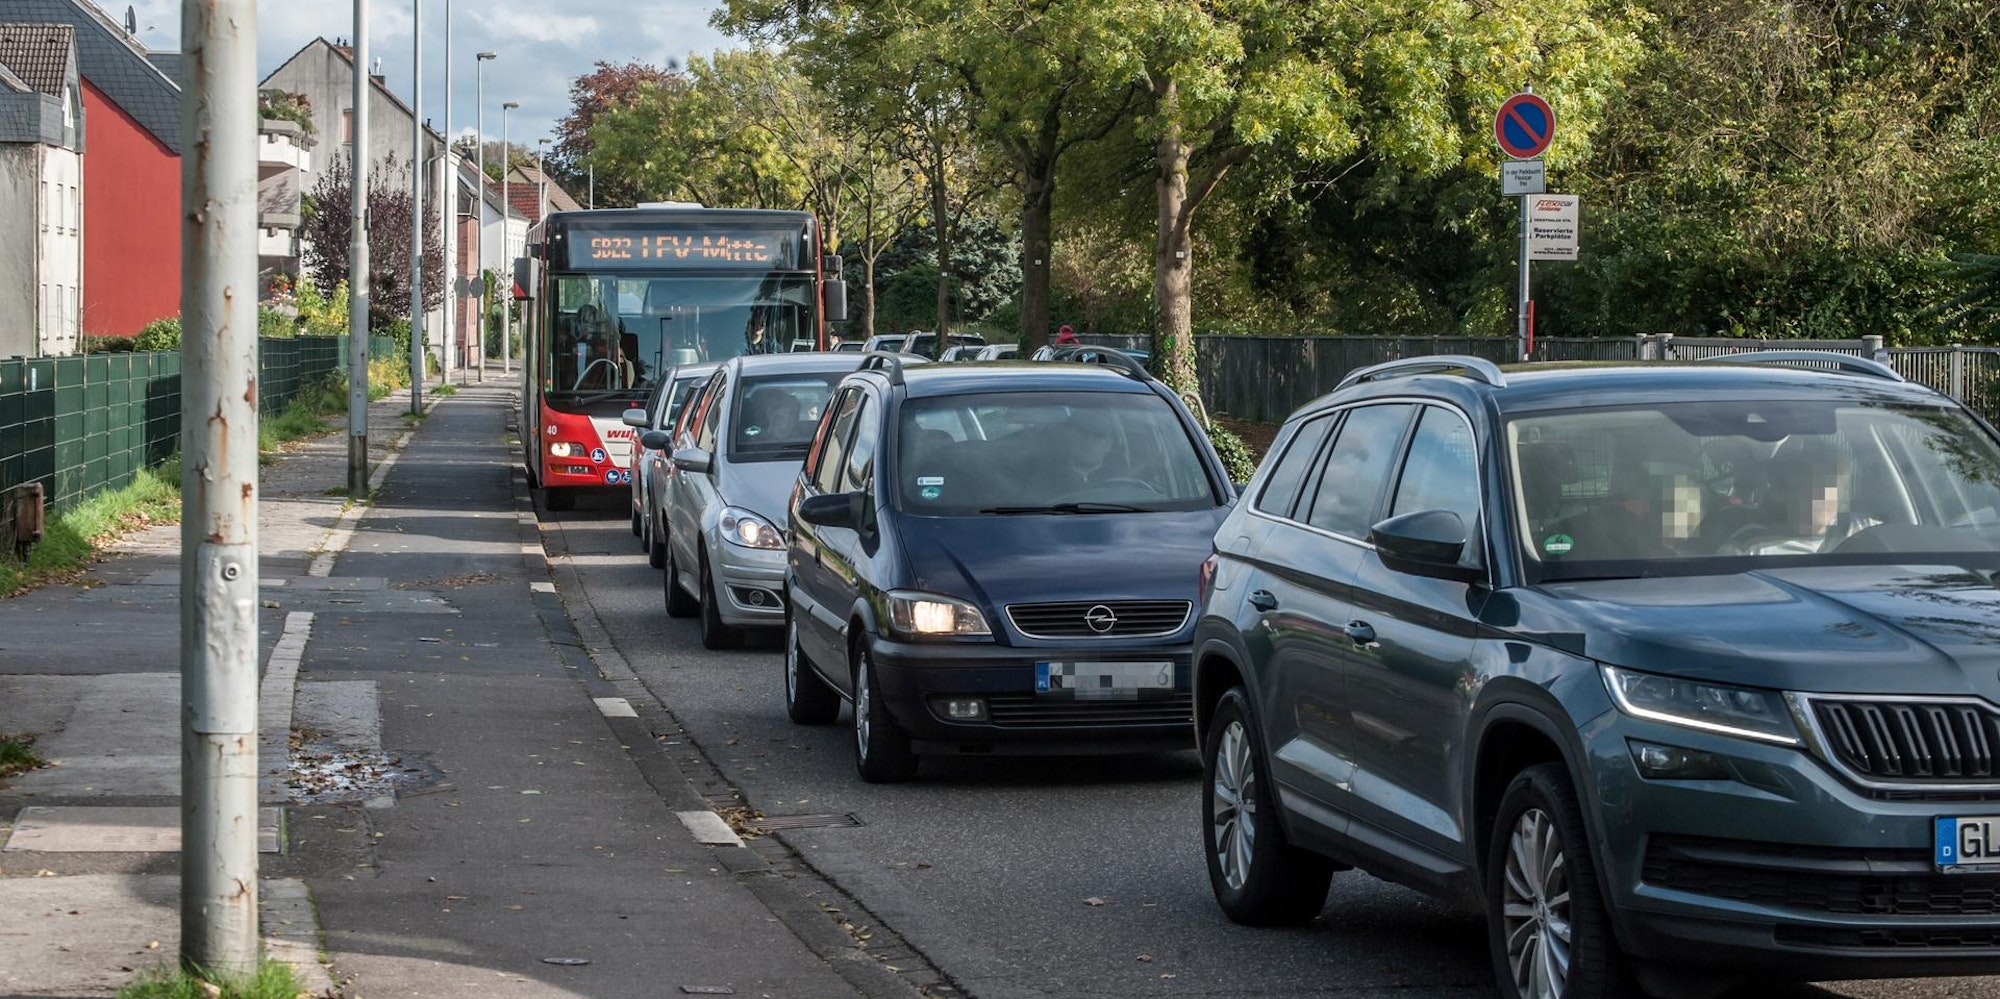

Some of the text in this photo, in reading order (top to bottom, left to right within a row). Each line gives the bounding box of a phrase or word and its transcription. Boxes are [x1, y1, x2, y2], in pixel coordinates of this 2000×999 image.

[591, 237, 631, 259] SB22
[547, 425, 558, 435] 40
[1960, 822, 2000, 858] GL
[1942, 846, 1952, 857] D
